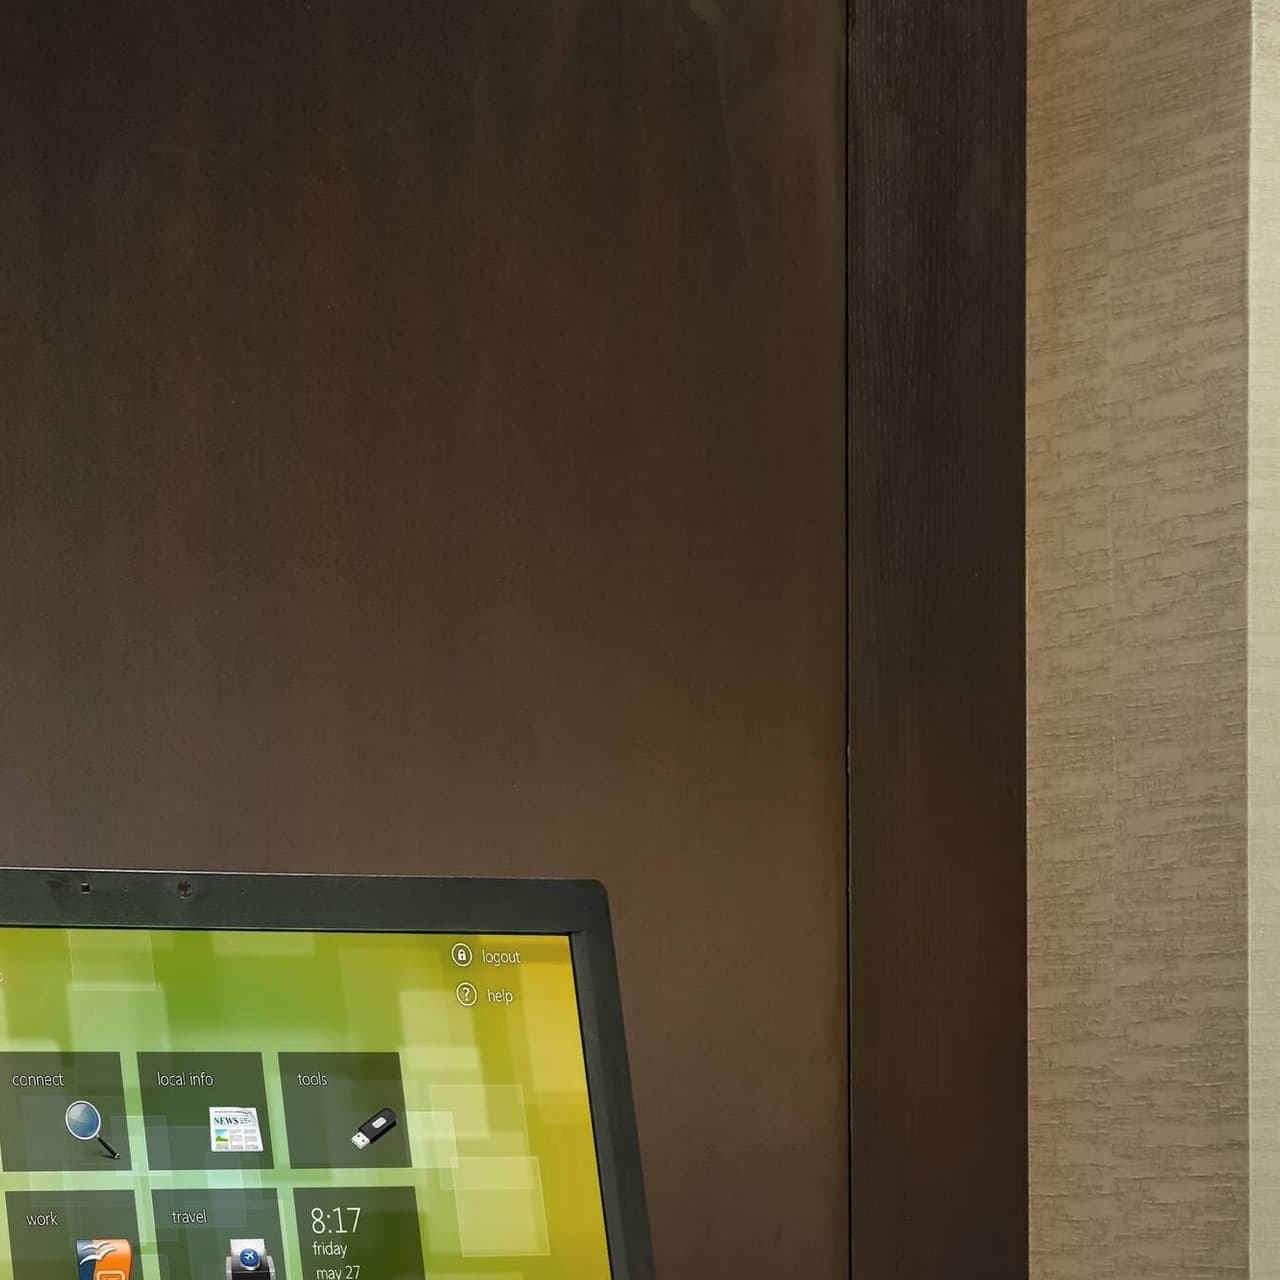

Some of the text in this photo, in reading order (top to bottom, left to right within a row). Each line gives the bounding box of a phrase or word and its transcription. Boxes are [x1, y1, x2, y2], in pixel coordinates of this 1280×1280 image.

[481, 949, 521, 967] logout
[487, 988, 513, 1006] help
[12, 1072, 64, 1087] connect
[157, 1071, 214, 1087] local info
[297, 1072, 328, 1086] tools
[214, 1116, 239, 1125] NEWS
[25, 1213, 59, 1227] work
[172, 1209, 208, 1224] travel
[310, 1207, 361, 1234] 8:17
[312, 1241, 348, 1258] friday
[345, 1265, 361, 1280] 27
